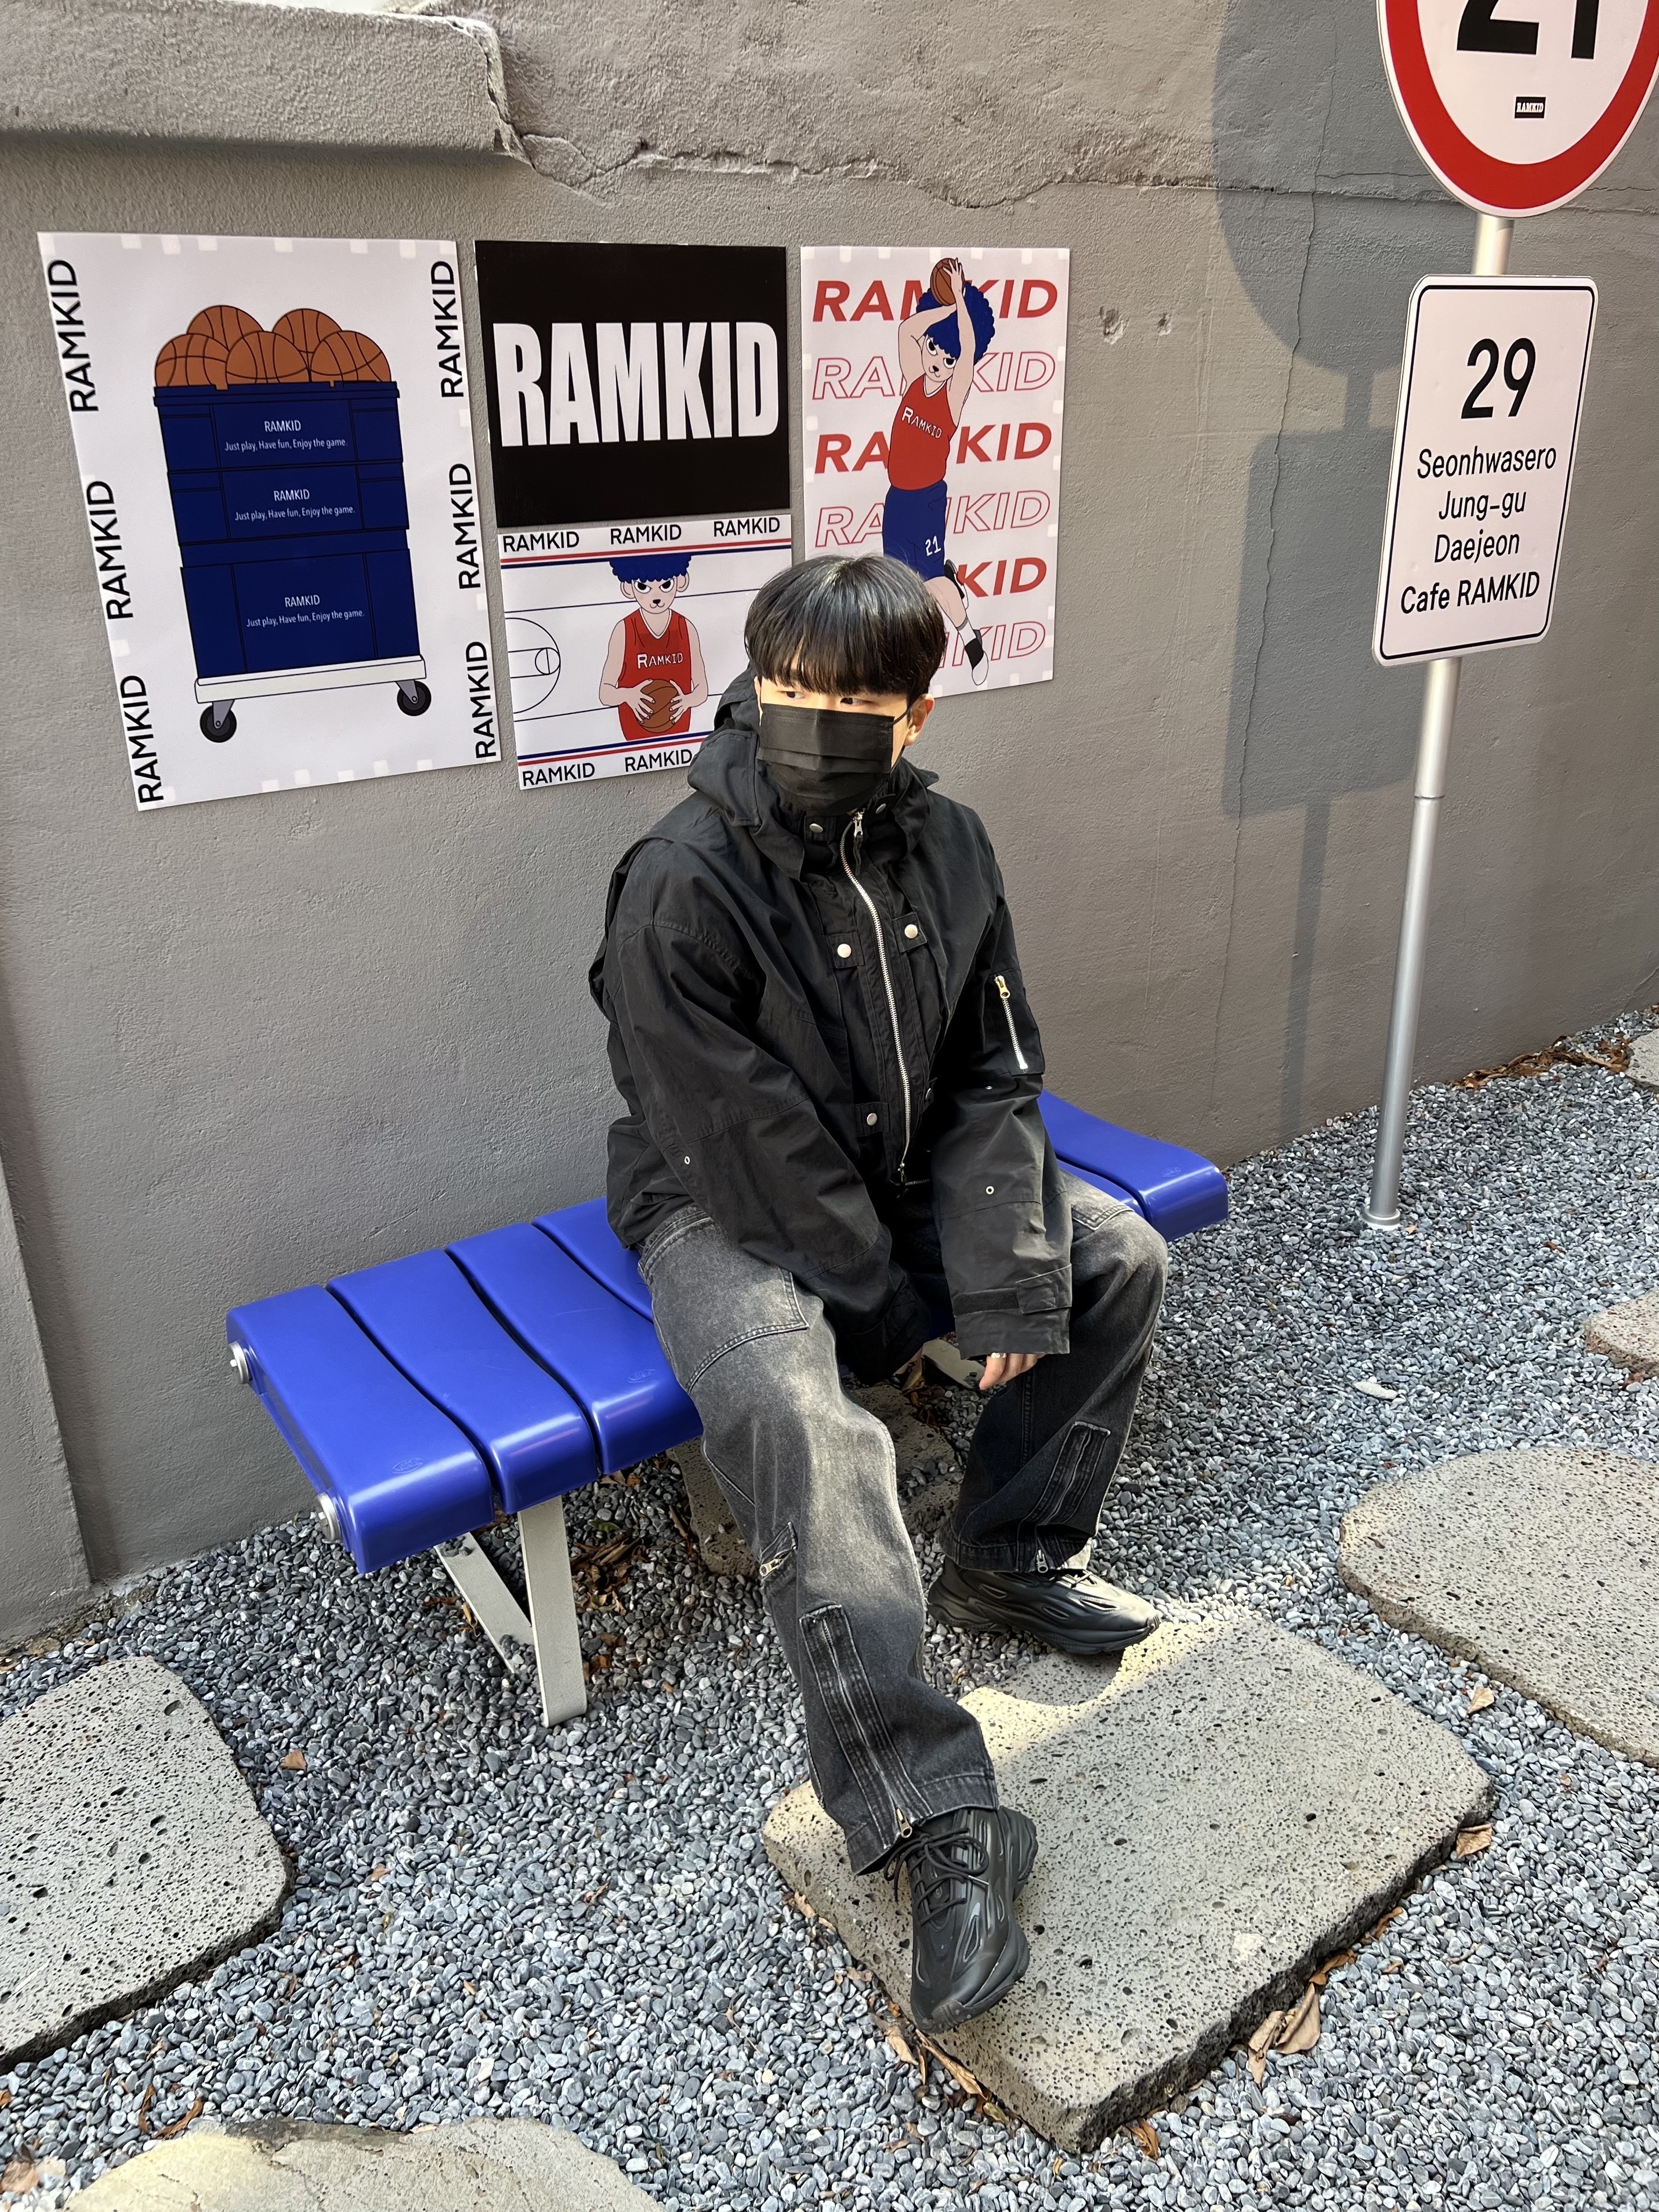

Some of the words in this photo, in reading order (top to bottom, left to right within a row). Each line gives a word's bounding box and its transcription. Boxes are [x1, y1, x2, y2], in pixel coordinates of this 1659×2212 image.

[1516, 102, 1544, 113] RAMKID
[48, 259, 99, 412] RAMKID
[431, 261, 465, 398] RAMKID
[493, 321, 779, 448] RAMKID
[1461, 338, 1536, 419] 29
[265, 420, 302, 433] RAMKID
[902, 407, 941, 438] RAMKID
[224, 442, 240, 451] Just
[258, 440, 277, 449] Have
[293, 438, 312, 450] Enjoy
[313, 438, 325, 447] the
[814, 422, 1052, 474] RAKID
[1417, 446, 1557, 478] Seonhwasero
[273, 489, 310, 502] RAMKID
[1439, 490, 1527, 520] Jung-gu
[235, 512, 250, 521] Just
[268, 510, 286, 518] Have
[302, 507, 320, 518] Enjoy
[321, 506, 333, 514] the
[448, 463, 481, 590] RAMKID
[815, 490, 1050, 547] RAKID
[86, 480, 133, 619] RAMKID
[503, 531, 580, 553] RAMKID
[610, 524, 682, 545] RAMKID
[713, 517, 781, 536] RAMKID
[925, 536, 941, 557] 21
[1435, 529, 1520, 563] Daejeon
[284, 594, 320, 608] RAMKID
[1401, 582, 1450, 614] Cafe
[1457, 571, 1540, 607] RAMKID
[247, 618, 261, 627] Just
[278, 615, 296, 625] Have
[311, 612, 331, 622] Enjoy
[331, 610, 343, 619] the
[637, 652, 683, 669] RAMKID
[465, 641, 496, 759] RAMKID
[120, 675, 165, 803] RAMKID
[522, 763, 595, 788] RAMKID
[625, 750, 693, 772] RAMKID
